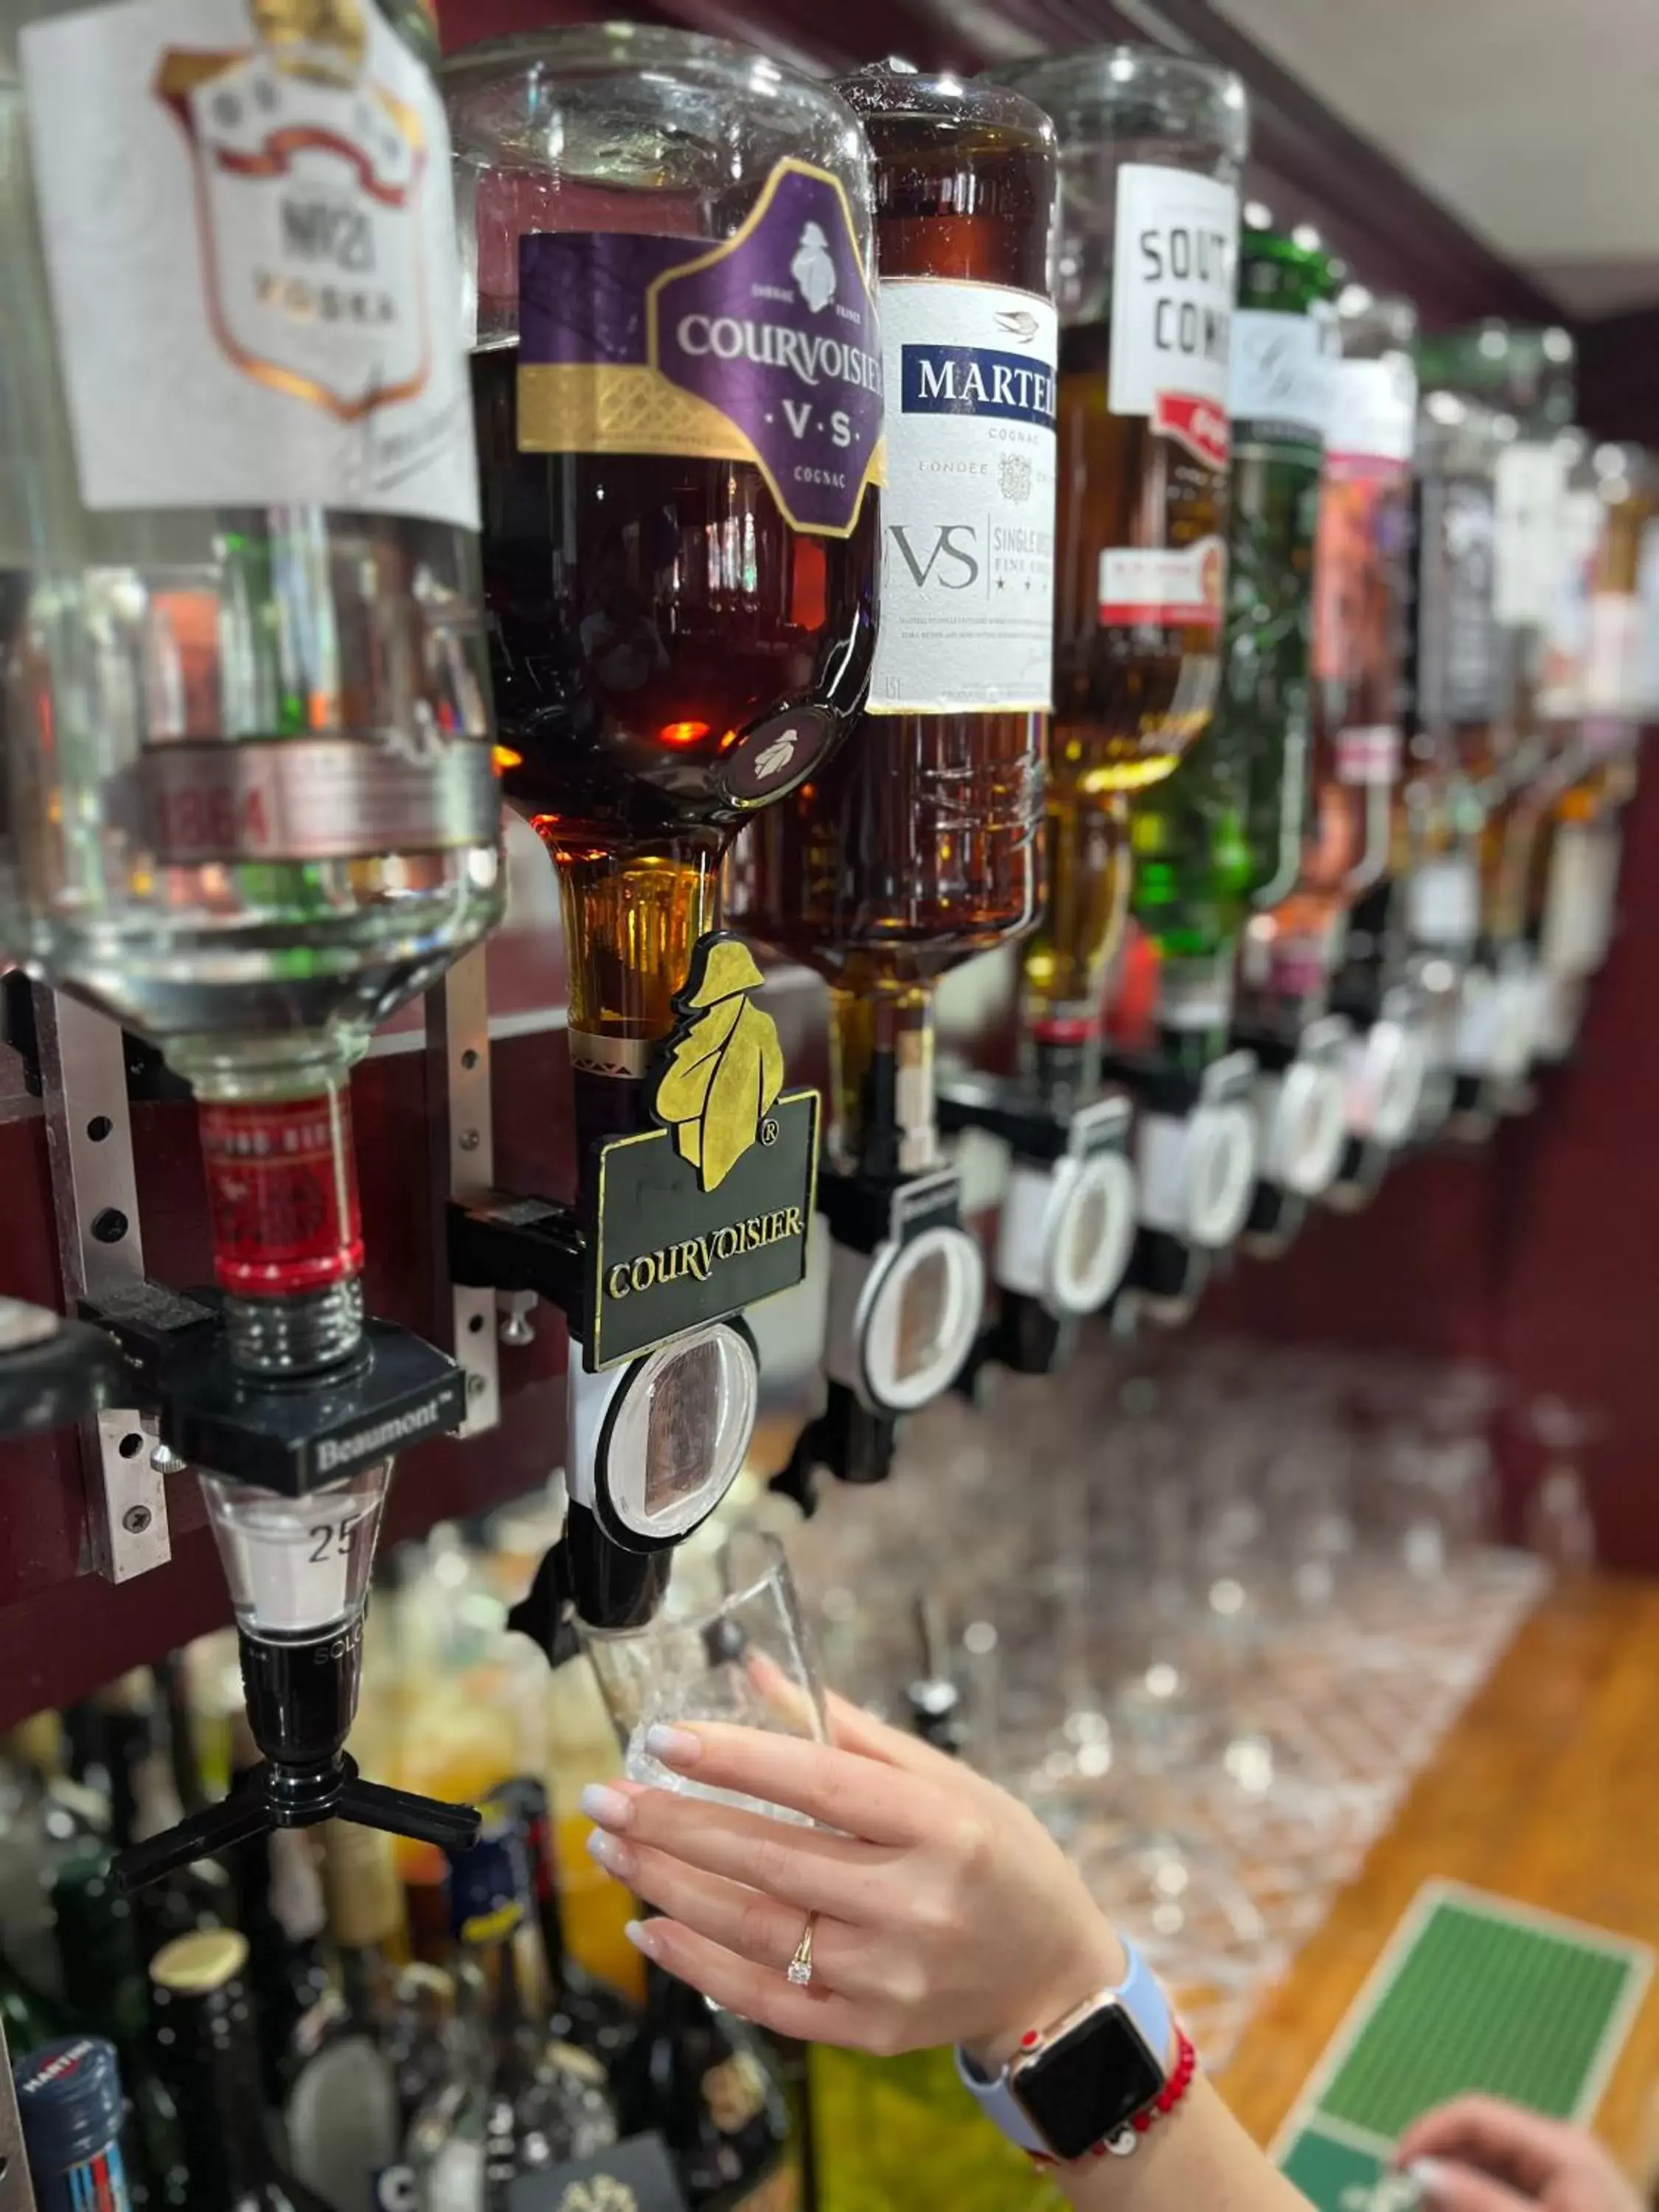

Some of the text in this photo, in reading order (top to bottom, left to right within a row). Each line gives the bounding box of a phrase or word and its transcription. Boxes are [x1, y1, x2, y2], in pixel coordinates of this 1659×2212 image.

[988, 427, 1040, 445] COGNAC
[793, 465, 846, 490] COGNAC
[887, 524, 978, 590] VS
[993, 526, 1036, 553] SINGLE
[609, 1206, 804, 1299] COURVOISIER
[308, 1512, 357, 1564] 25
